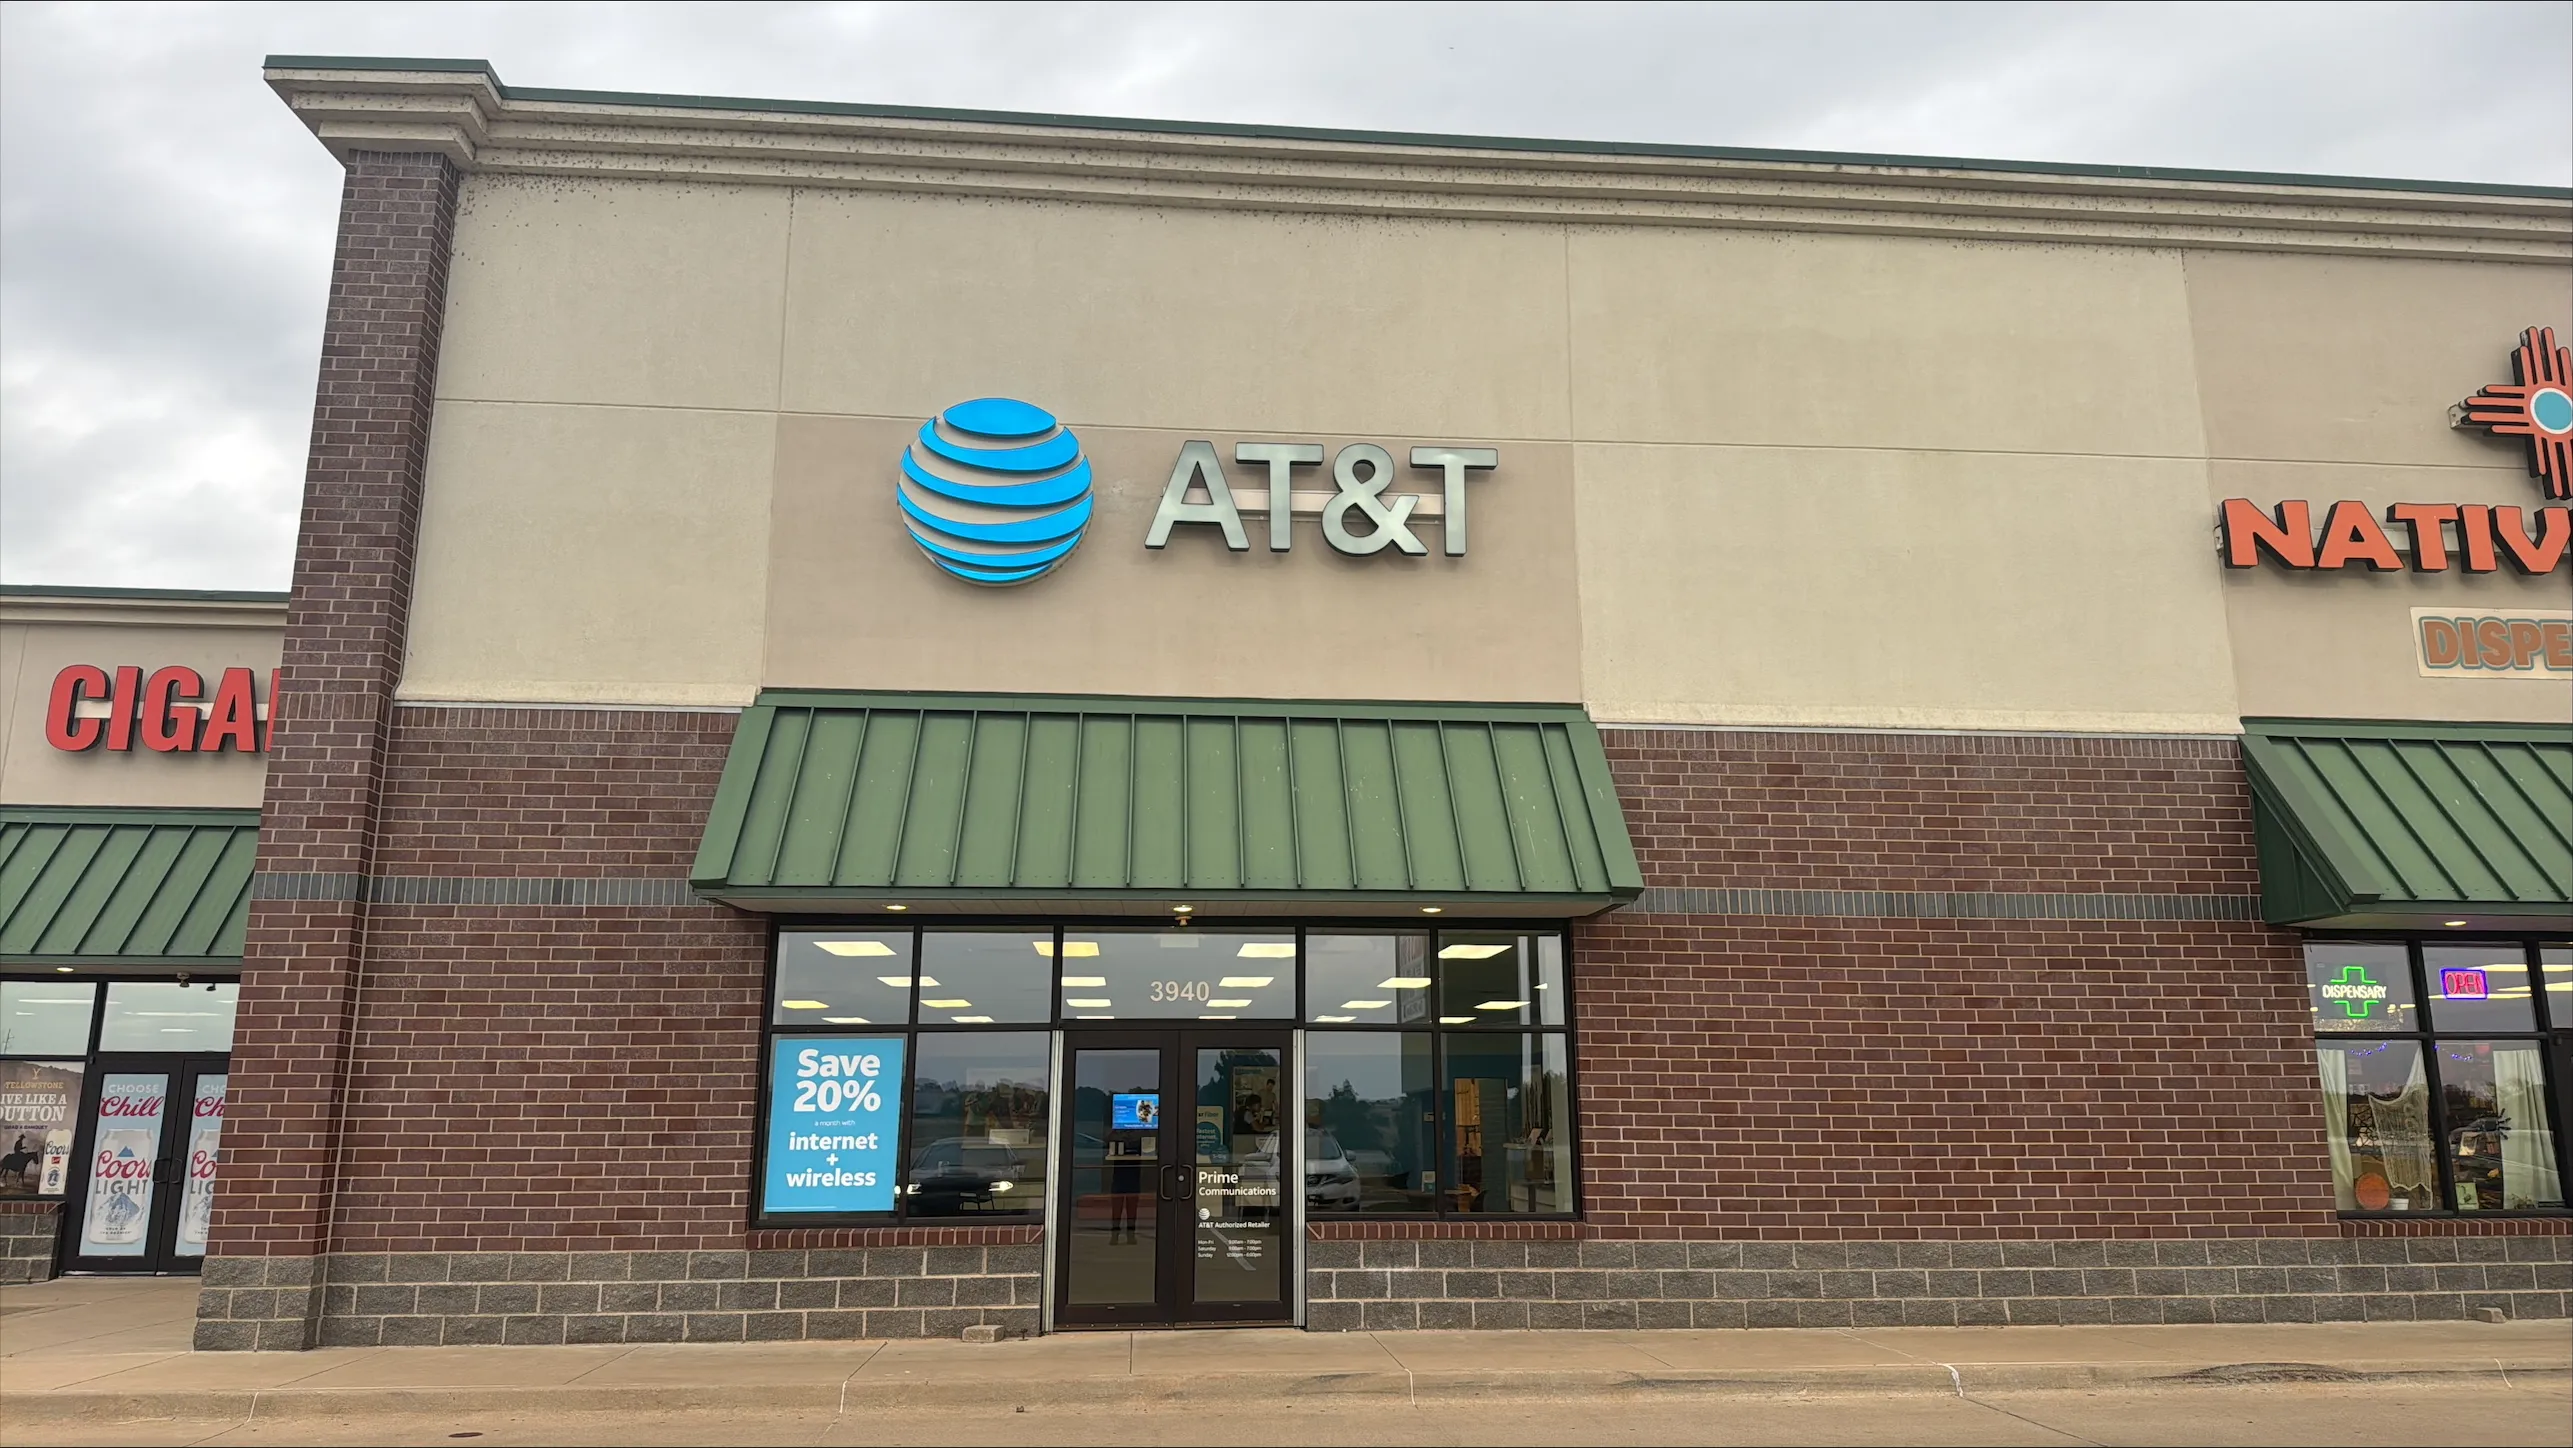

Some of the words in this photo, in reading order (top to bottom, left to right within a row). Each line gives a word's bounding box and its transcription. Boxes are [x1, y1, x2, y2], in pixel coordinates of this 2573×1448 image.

[1144, 440, 1499, 557] AT&T
[1150, 980, 1210, 1002] 3940
[2322, 984, 2387, 999] DISPENSARY
[2445, 972, 2484, 996] OPEN
[796, 1048, 881, 1078] Save
[4, 1081, 65, 1090] YELLOWSTONE
[108, 1083, 160, 1094] CHOOSE
[25, 1093, 57, 1105] LIKE
[57, 1093, 68, 1105] A
[793, 1079, 881, 1113] 20%
[100, 1095, 165, 1117] Chill
[819, 1119, 841, 1127] month
[841, 1119, 856, 1127] with
[789, 1131, 879, 1151] internet
[786, 1168, 876, 1188] wireless
[1199, 1171, 1239, 1184] Prime
[95, 1179, 149, 1196] LIGHT
[1199, 1187, 1277, 1197] Communications
